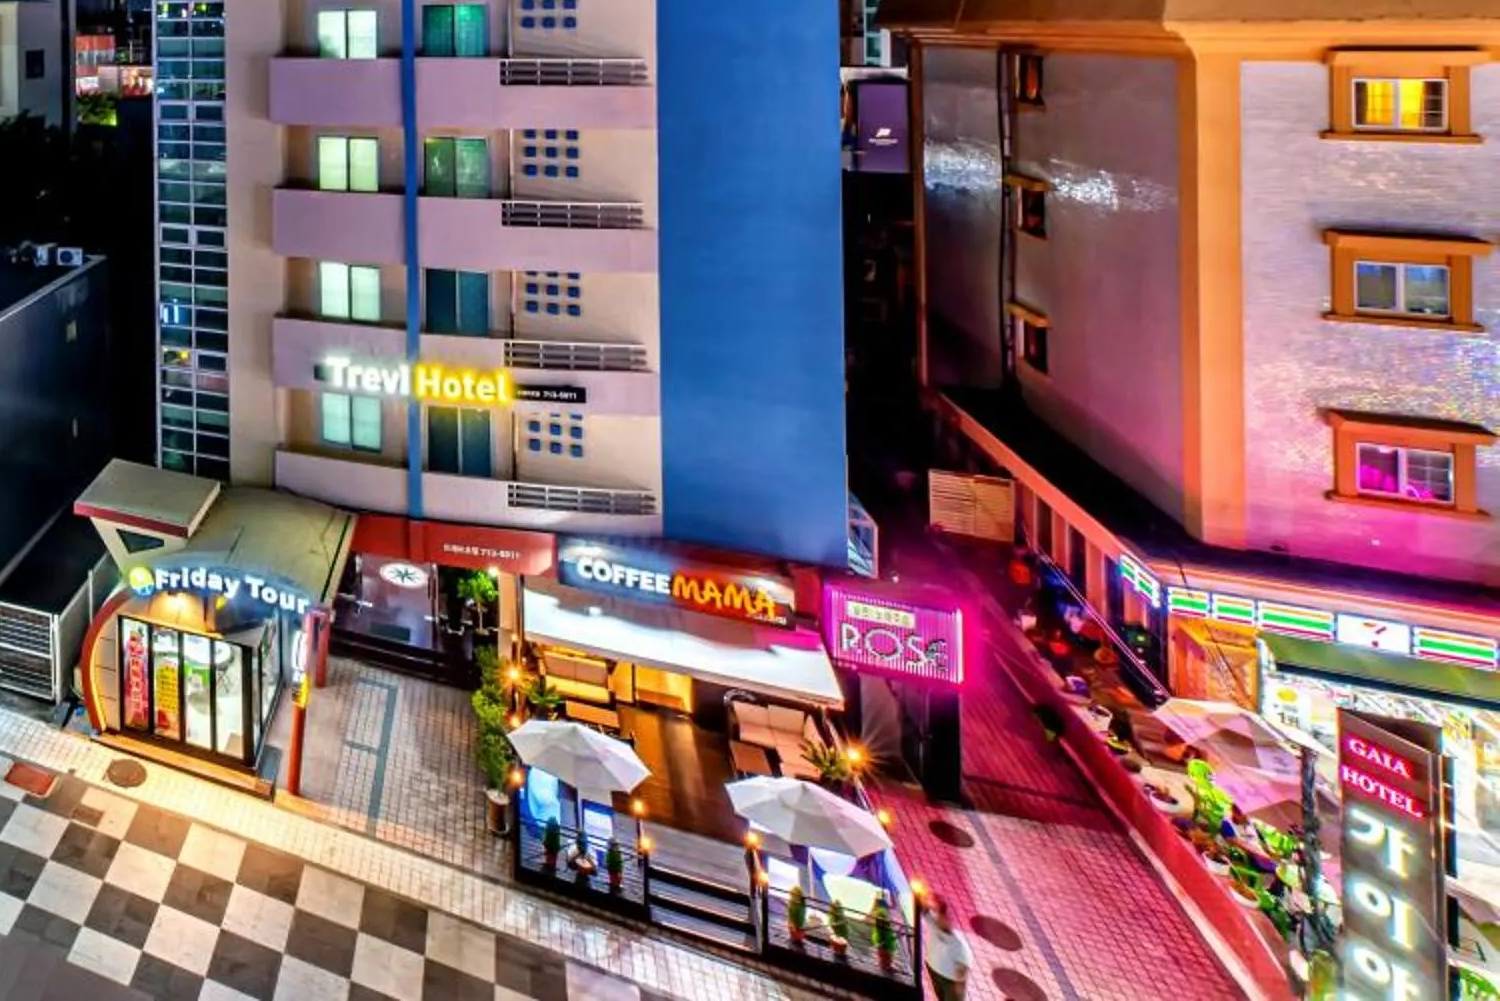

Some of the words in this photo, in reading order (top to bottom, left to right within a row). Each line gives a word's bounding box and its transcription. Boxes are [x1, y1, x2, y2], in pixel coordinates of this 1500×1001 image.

[325, 355, 410, 396] Trevi
[415, 368, 509, 402] Hotel
[155, 566, 241, 598] Friday
[244, 574, 311, 615] Tour
[576, 556, 670, 595] COFFEE
[672, 573, 777, 619] MAMA
[1348, 738, 1411, 779] GAIA
[1341, 764, 1423, 818] HOTEL
